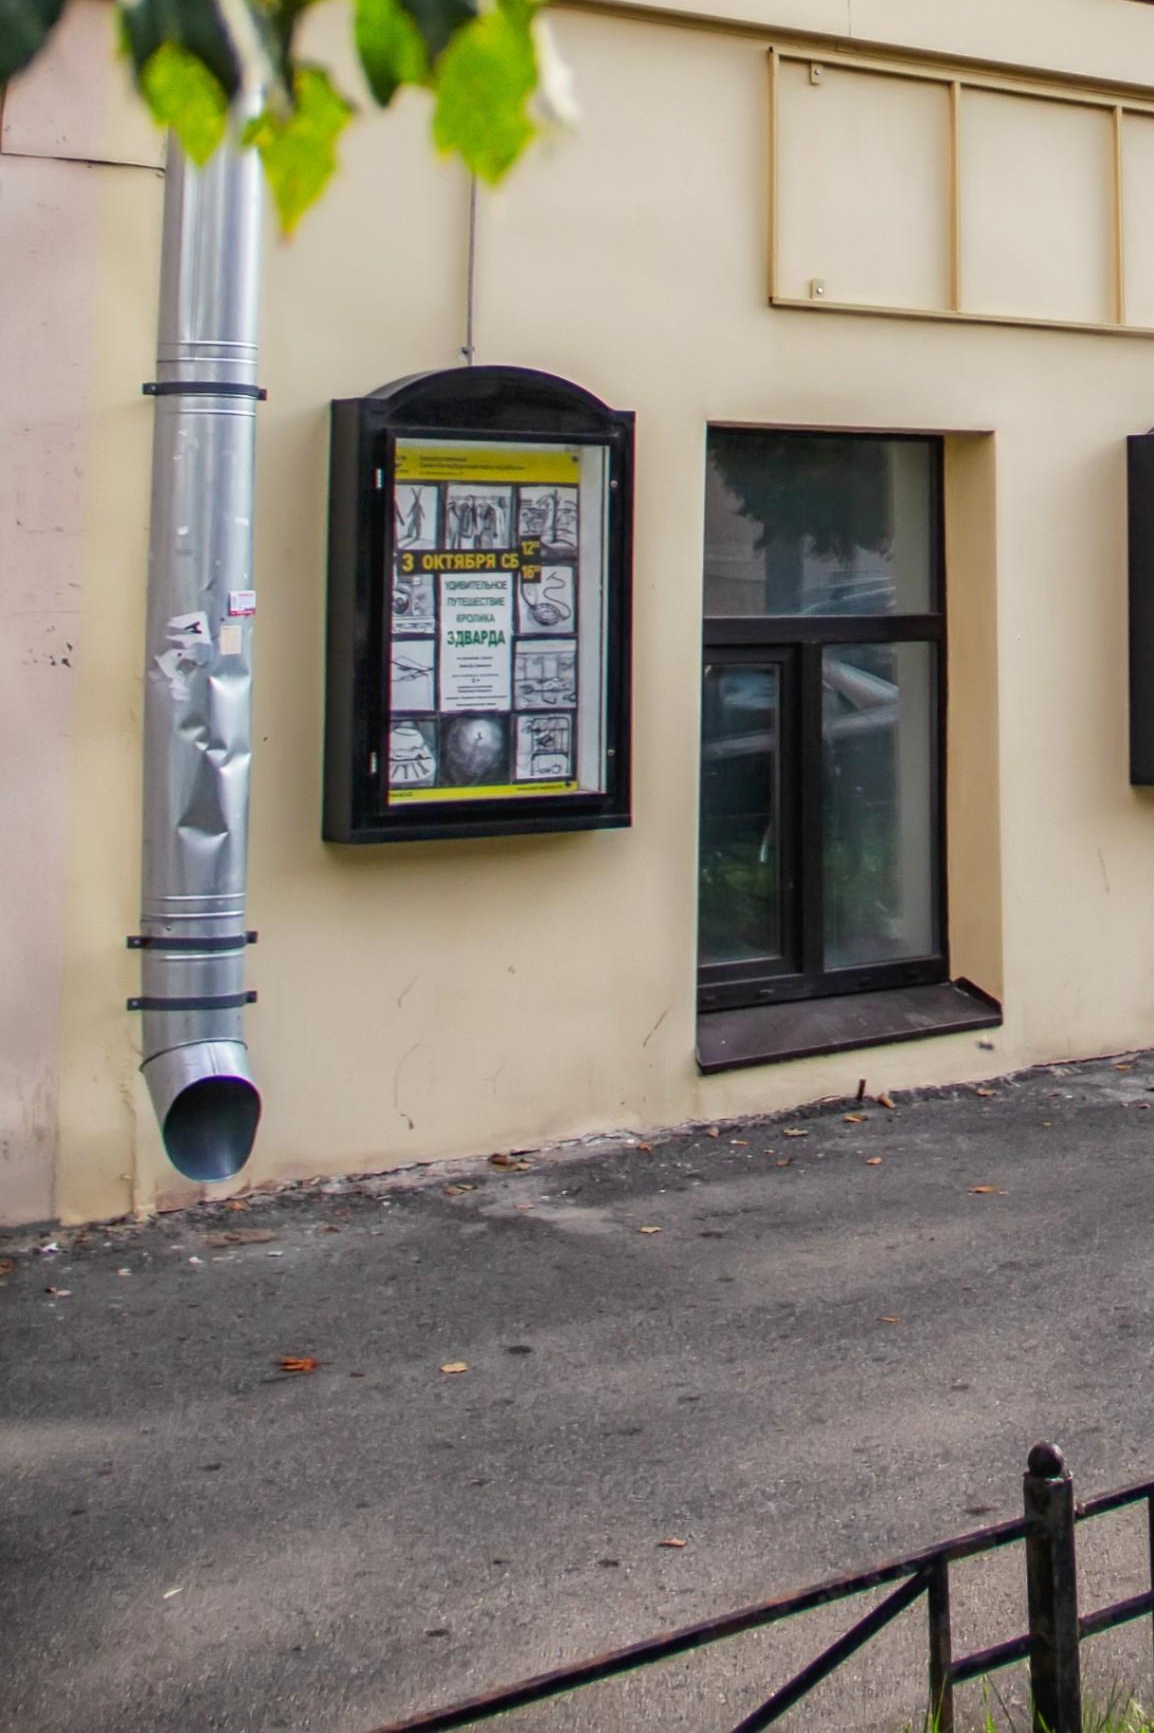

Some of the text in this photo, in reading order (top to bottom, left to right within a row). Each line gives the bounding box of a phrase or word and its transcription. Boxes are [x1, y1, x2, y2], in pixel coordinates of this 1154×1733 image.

[402, 553, 520, 571] 3 ОКТЯБРЯ СБ
[445, 580, 508, 591] УДИВИТЕЛЬНОЕ
[447, 597, 505, 607] ПУТЕШЕСТВИЕ
